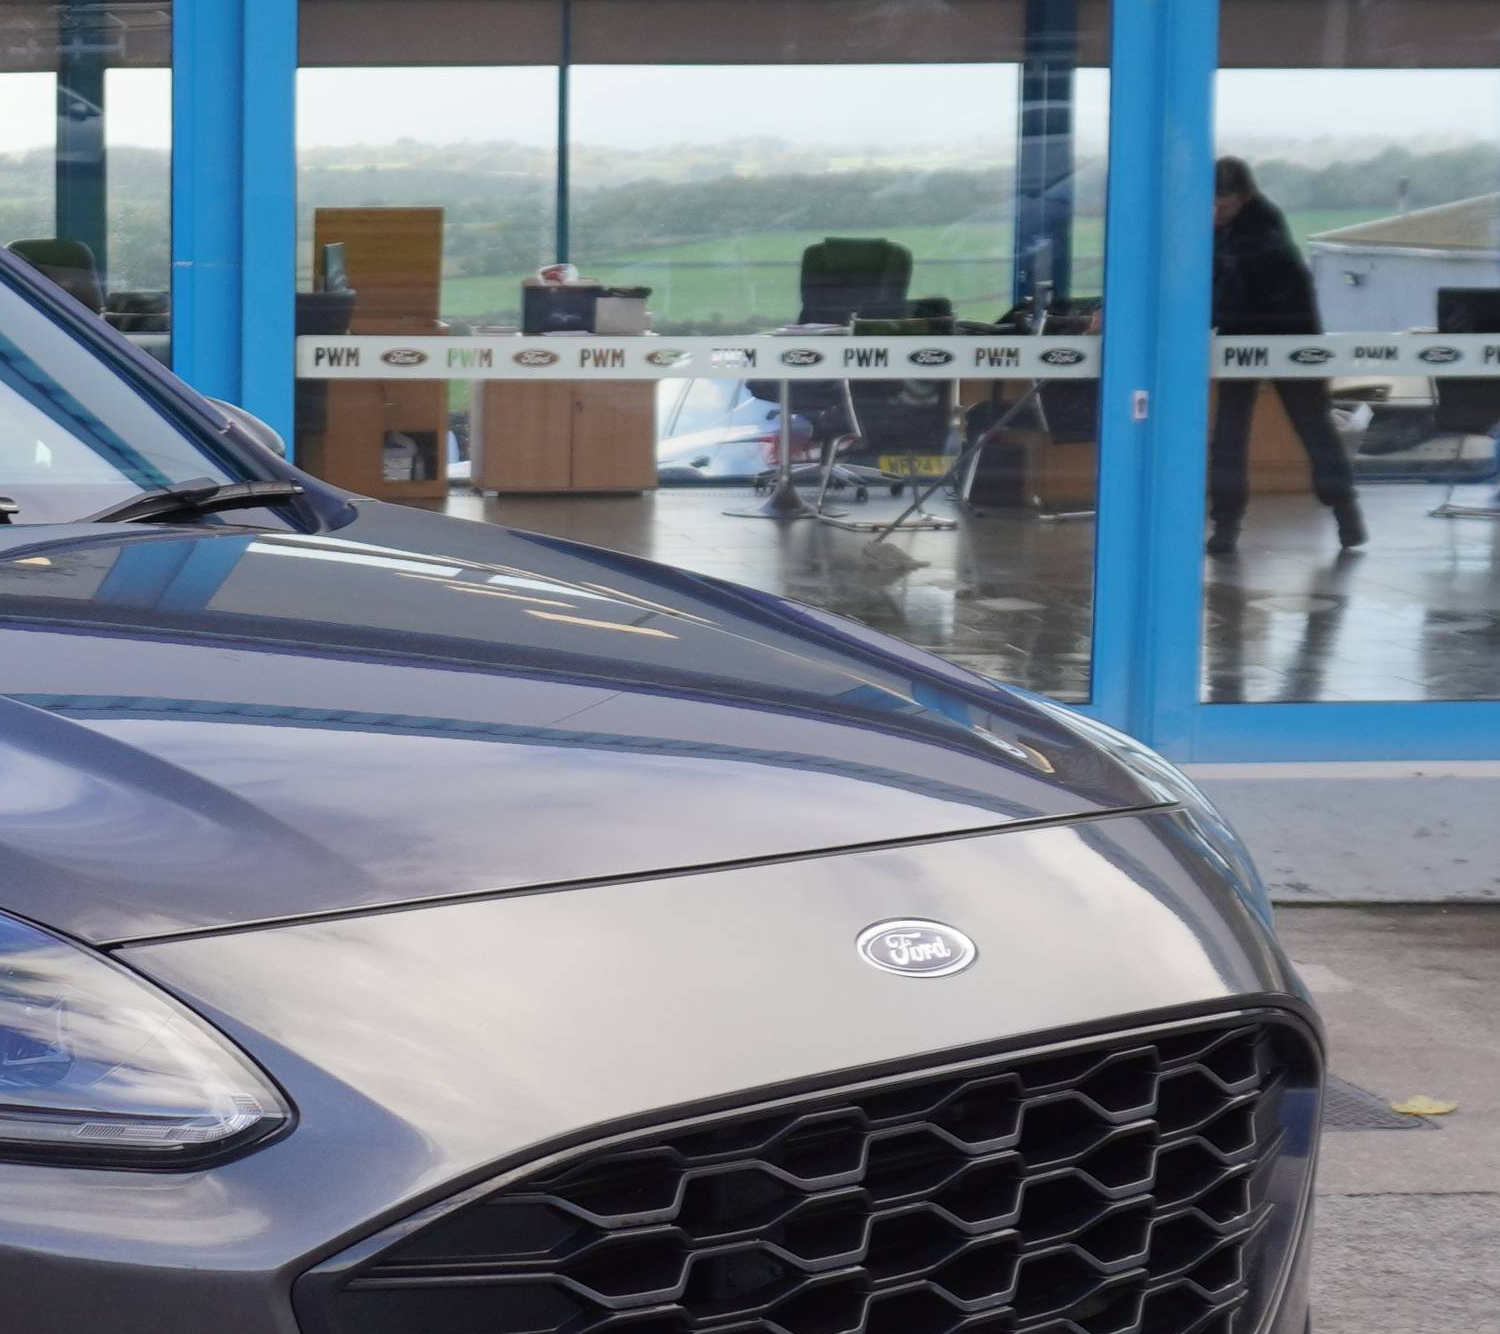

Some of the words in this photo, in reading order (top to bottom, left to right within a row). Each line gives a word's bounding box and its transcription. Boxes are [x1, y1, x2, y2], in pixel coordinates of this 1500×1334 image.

[314, 347, 360, 367] PWM
[447, 348, 493, 368] PWM
[579, 348, 625, 368] PWM
[843, 348, 889, 368] PWM
[974, 347, 1020, 368] PWM
[1223, 346, 1269, 367] PWM
[884, 931, 952, 966] Ford
